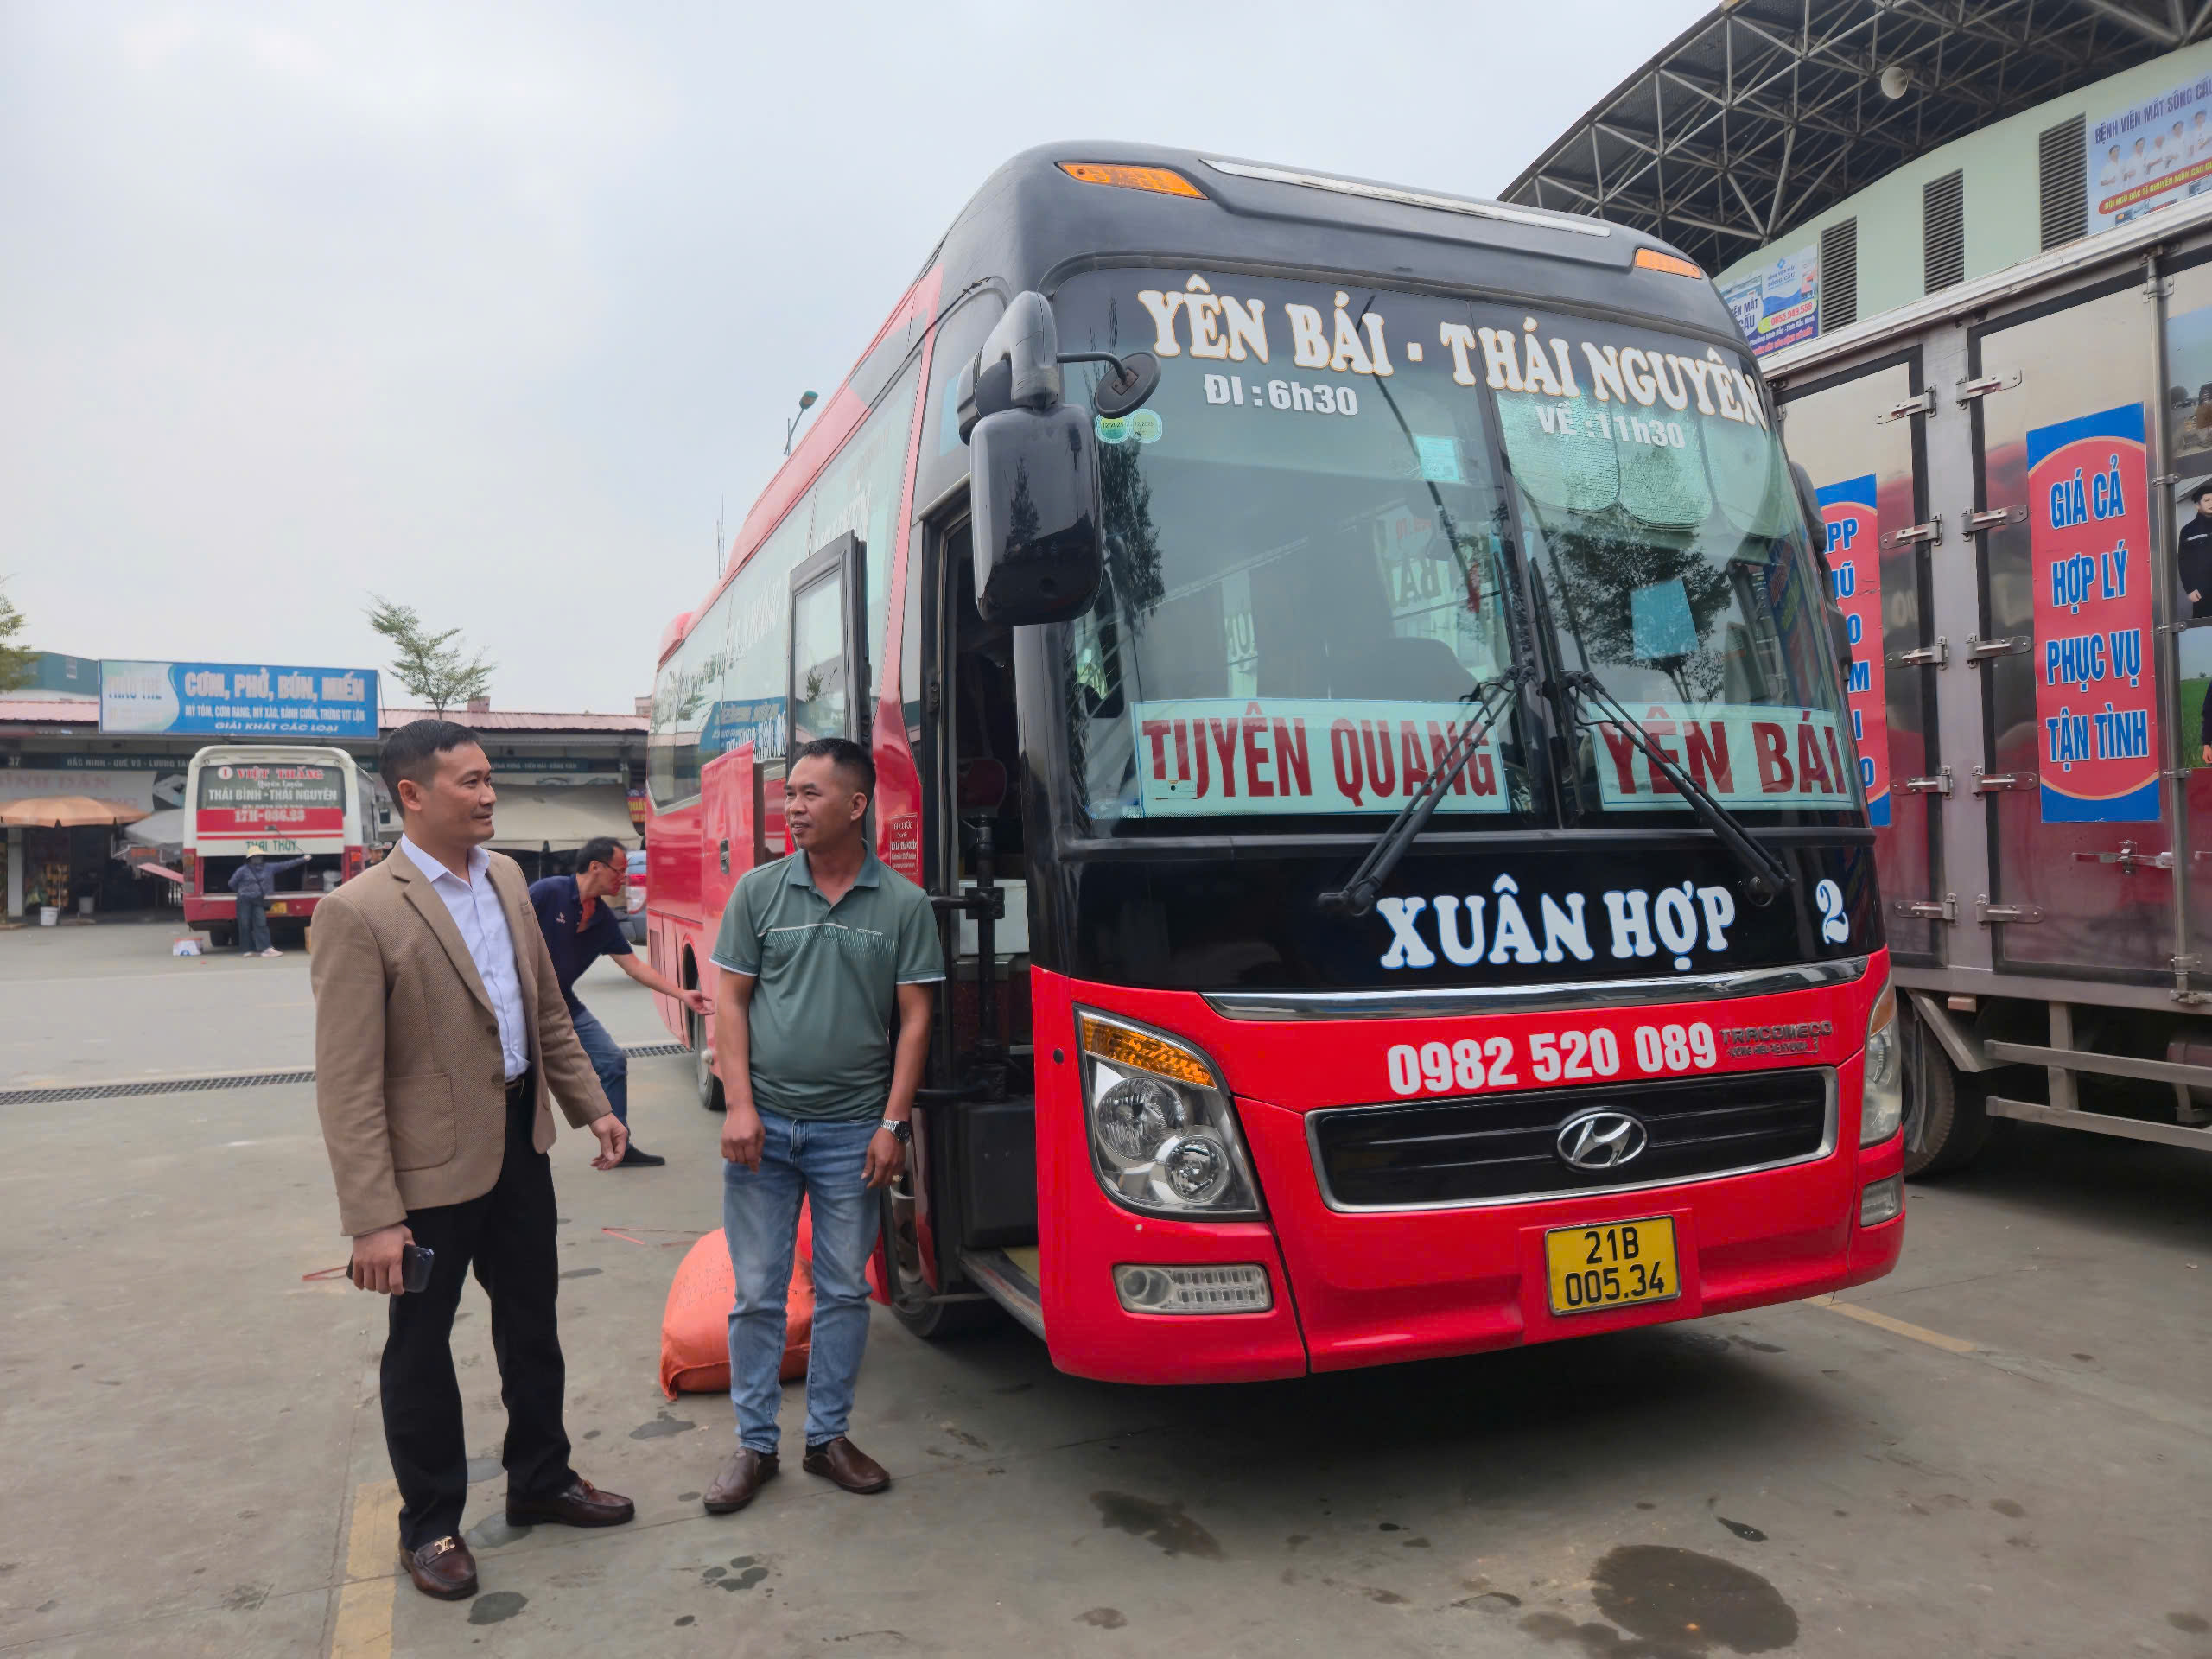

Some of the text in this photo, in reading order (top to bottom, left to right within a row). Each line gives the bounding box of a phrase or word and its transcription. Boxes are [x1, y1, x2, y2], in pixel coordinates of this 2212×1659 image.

[2166, 89, 2193, 112] SÔNG
[1137, 274, 1269, 364] YÊN
[1285, 290, 1394, 377] BÁI
[1439, 316, 1580, 397] THÁI
[1580, 341, 1768, 430] NGUYÊN
[1204, 372, 1244, 406] ĐI
[1268, 378, 1359, 416] 6h30
[1535, 401, 1577, 435] VỀ
[1597, 408, 1686, 449] 11h30
[2050, 454, 2126, 531] GIÁ CẢ
[2051, 540, 2129, 614] HỢP LÝ
[2046, 628, 2141, 695] PHỤC VỤ
[1141, 701, 1497, 807] TUYÊN QUANG
[1599, 705, 1847, 795] YÊN BÁI
[2046, 702, 2149, 772] TẬN TÌNH
[208, 787, 233, 801] THÁI
[235, 786, 262, 801] BÌNH
[269, 787, 293, 801] THÁI
[296, 787, 337, 801] NGUYÊN
[276, 766, 325, 779] THẮNG
[1375, 873, 1851, 971] XUÂN HỢP 2
[1386, 1021, 1718, 1096] 0982 520 089
[1719, 1020, 1833, 1045] TRACOMECO
[1586, 1225, 1640, 1265] 21B
[1564, 1260, 1665, 1307] 005.34
